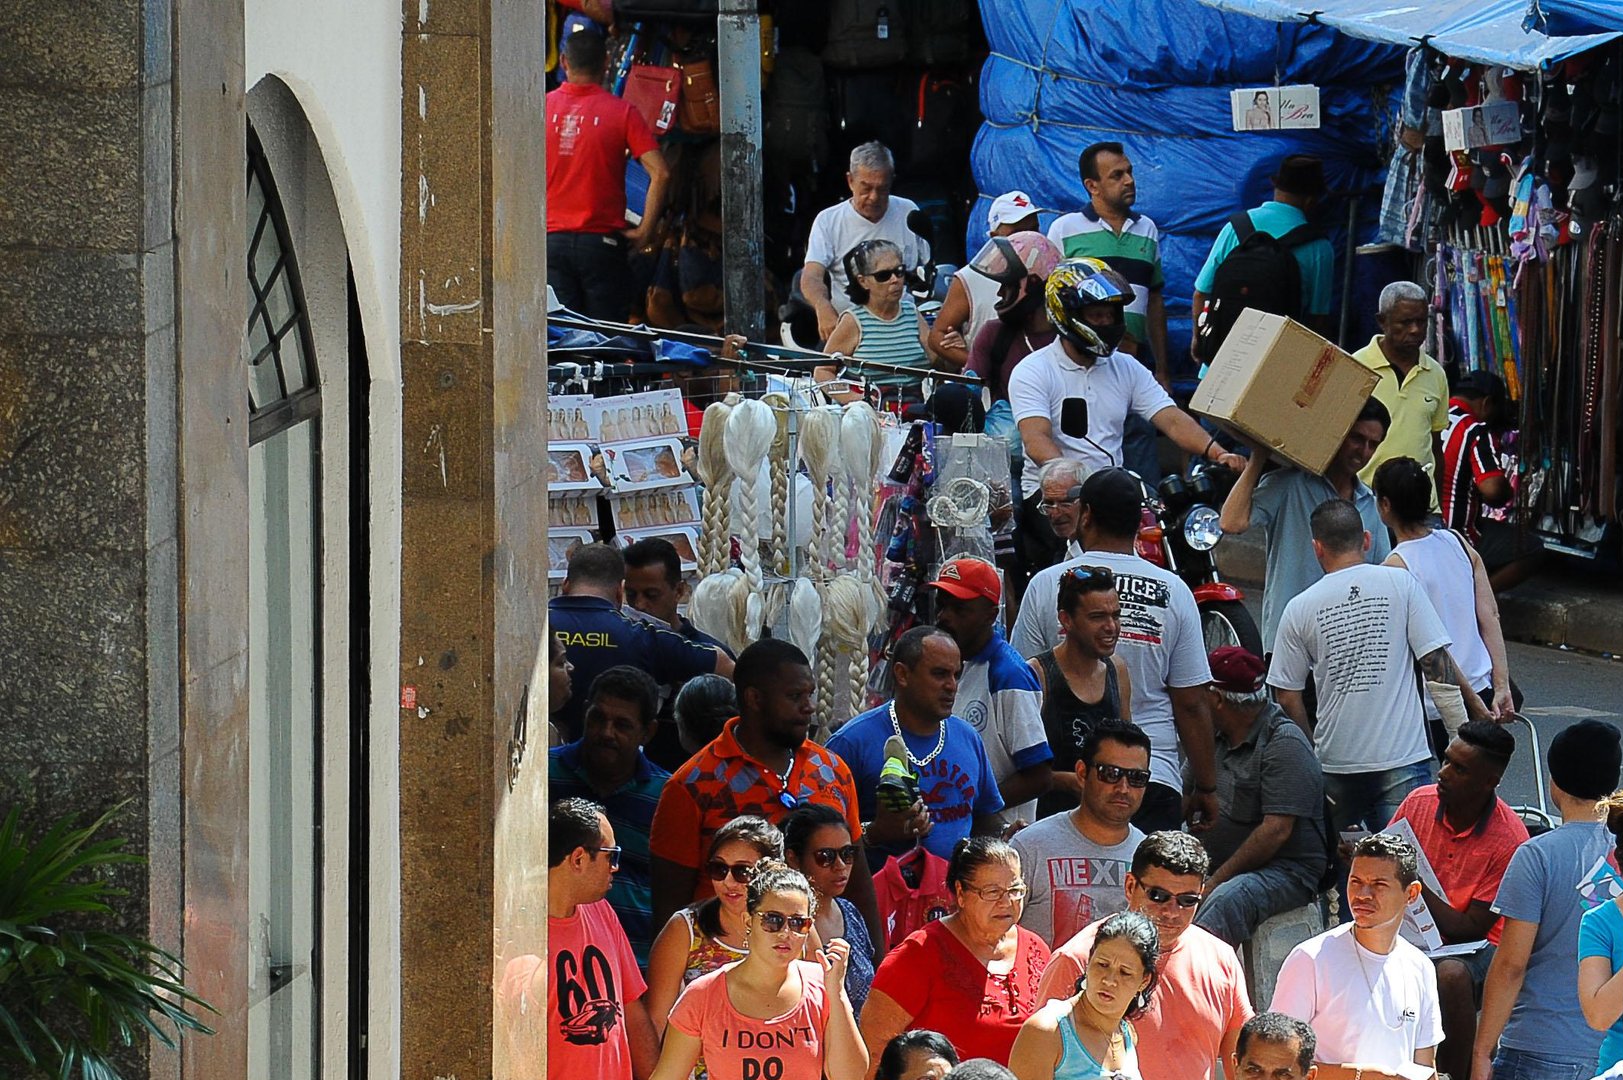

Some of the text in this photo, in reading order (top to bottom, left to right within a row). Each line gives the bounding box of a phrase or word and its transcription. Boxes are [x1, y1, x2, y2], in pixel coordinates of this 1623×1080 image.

[556, 944, 616, 1020] 60
[722, 1026, 812, 1049] I DON'T
